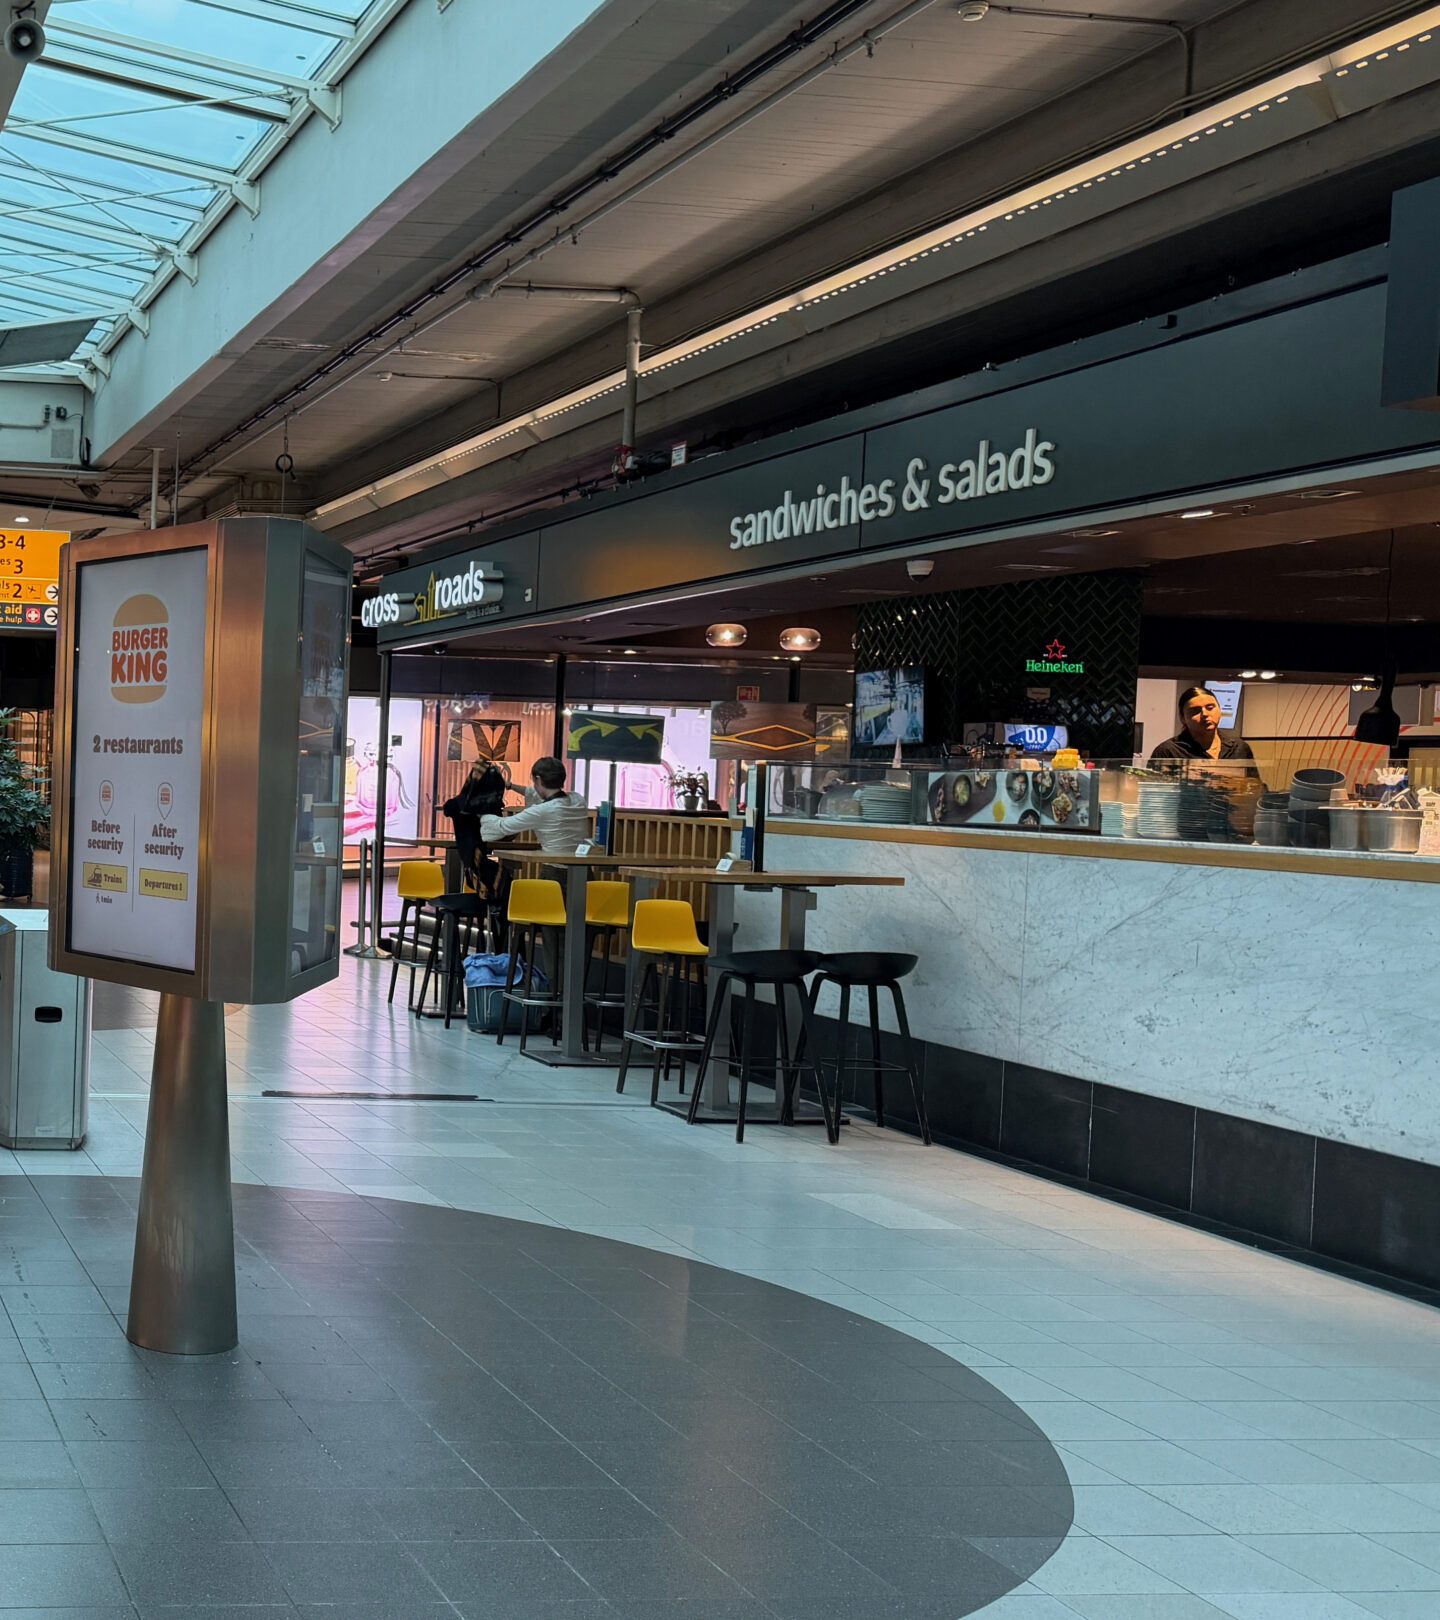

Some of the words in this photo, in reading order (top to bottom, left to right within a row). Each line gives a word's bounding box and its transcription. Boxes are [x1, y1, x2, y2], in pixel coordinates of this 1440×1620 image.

[729, 476, 896, 550] sandwiches
[902, 457, 930, 511] &
[937, 428, 1056, 504] salads
[13, 559, 24, 574] 3
[12, 583, 23, 599] 2
[361, 593, 400, 627] cross
[435, 561, 484, 610] roads
[4, 603, 23, 615] aid
[5, 615, 23, 624] hulp
[112, 627, 168, 652] BURGER
[111, 650, 168, 684] KING
[1025, 659, 1085, 673] Heineken
[93, 734, 101, 753] 2
[103, 737, 184, 755] restaurants
[91, 819, 121, 834] Before
[151, 823, 177, 839] After
[87, 837, 124, 854] security
[144, 842, 184, 860] security
[103, 873, 123, 884] Trains
[144, 878, 178, 891] Departures
